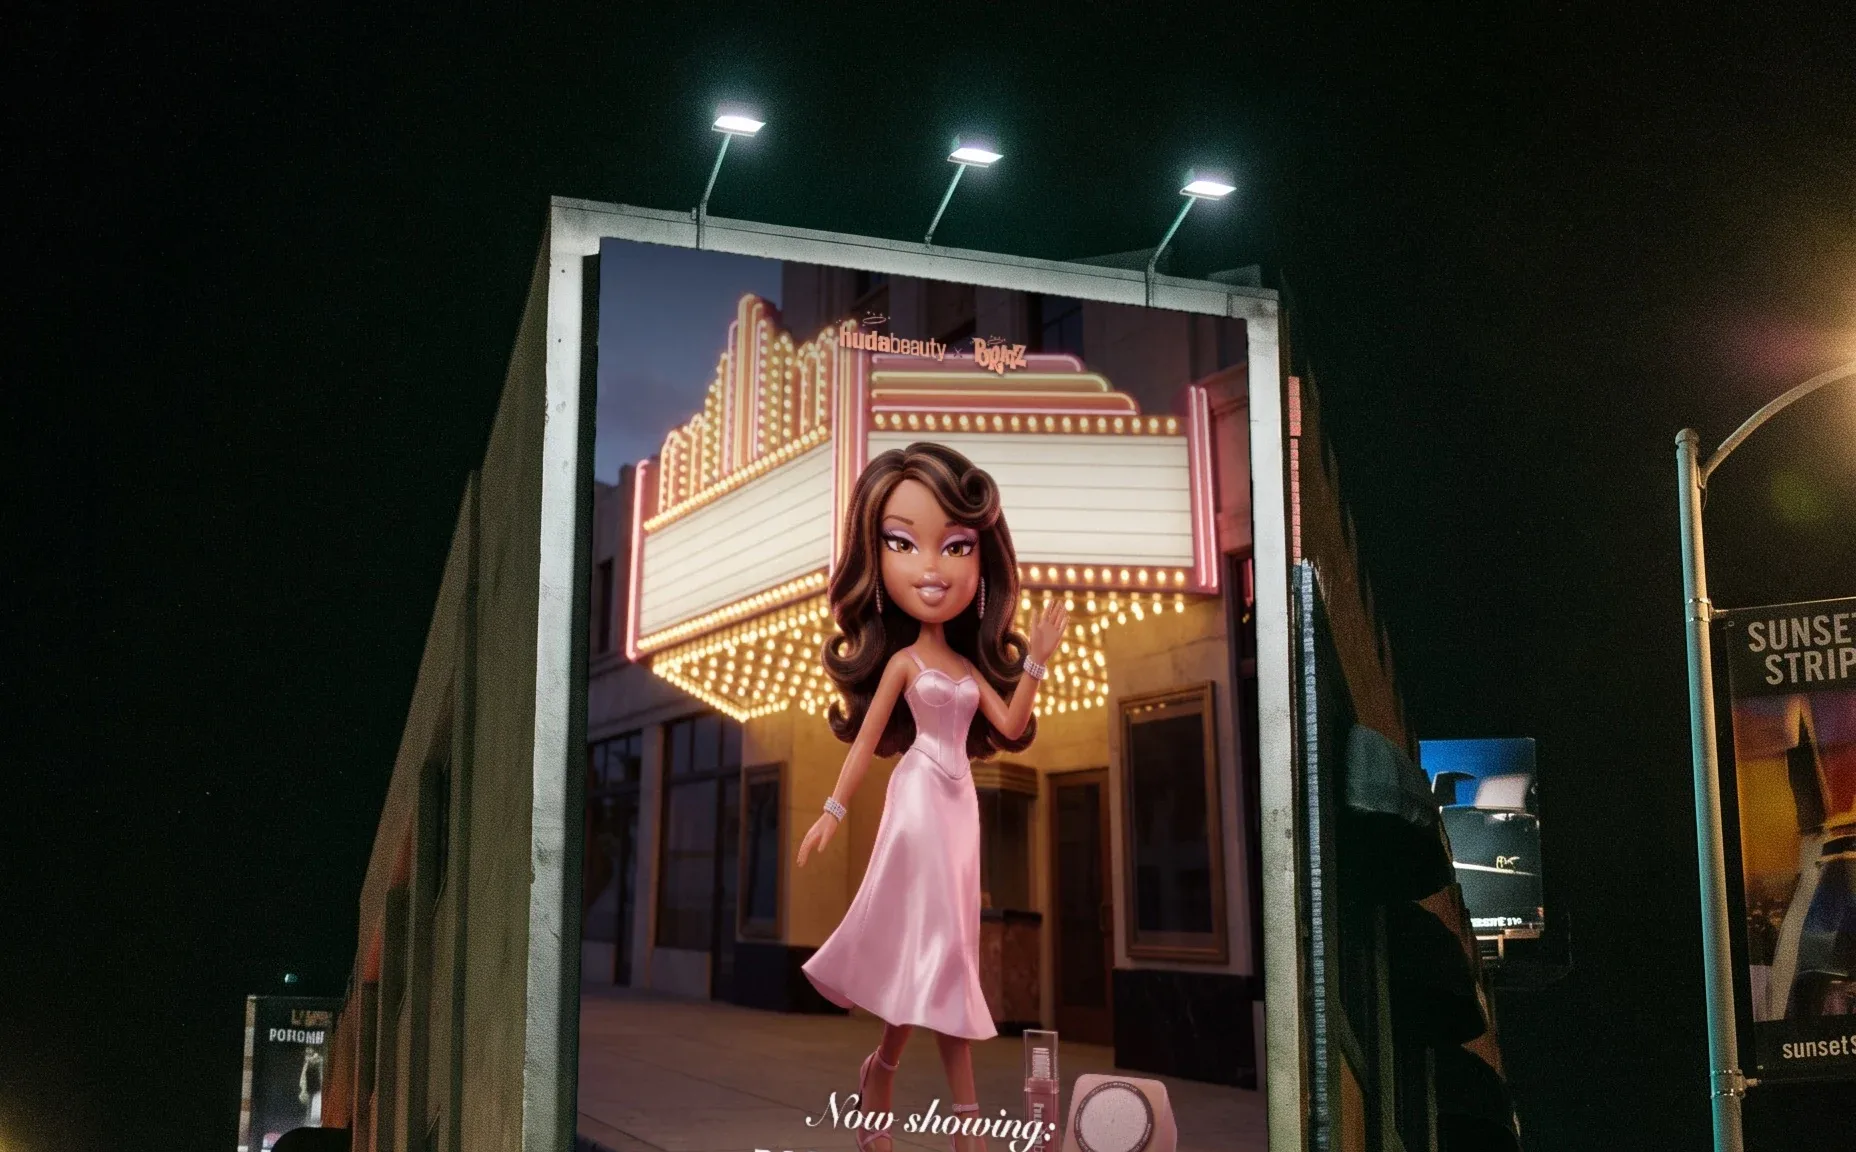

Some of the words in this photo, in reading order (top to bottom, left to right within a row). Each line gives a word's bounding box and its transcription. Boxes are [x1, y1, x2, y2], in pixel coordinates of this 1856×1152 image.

[839, 324, 946, 361] hudabeauty
[1765, 647, 1856, 685] STRIP
[806, 1091, 899, 1131] Now
